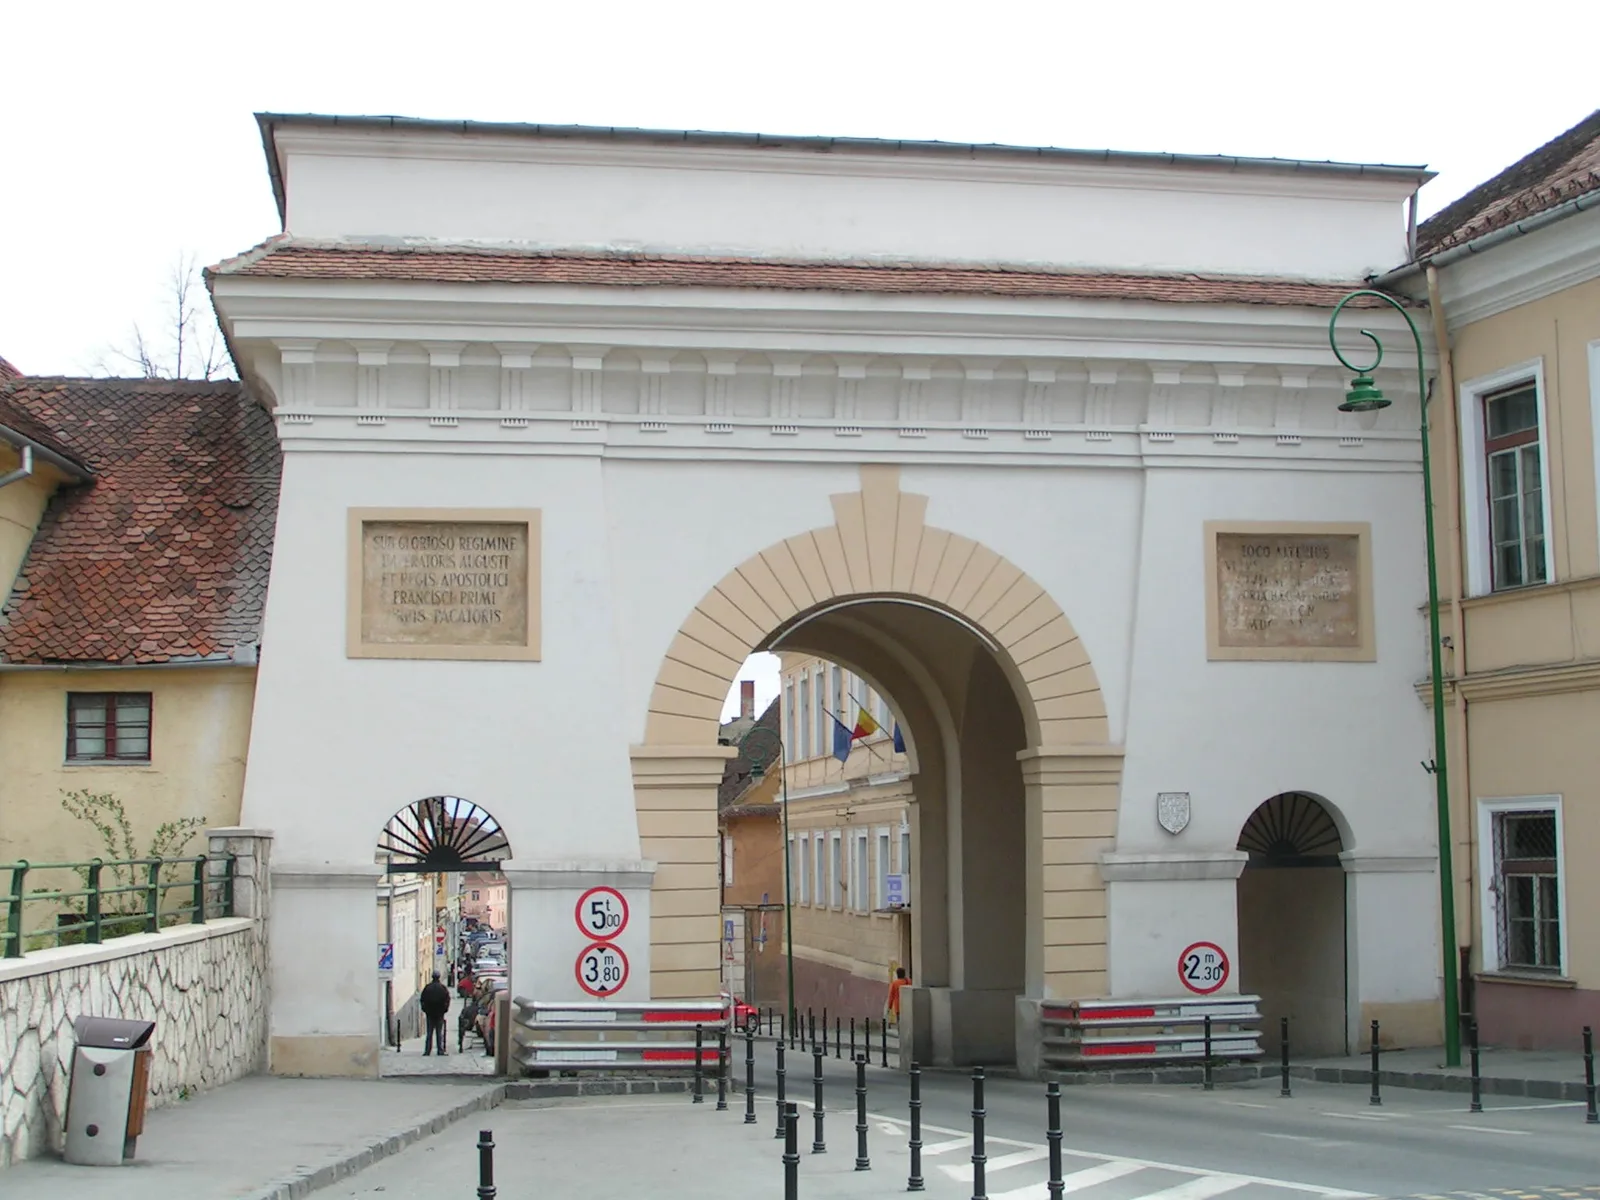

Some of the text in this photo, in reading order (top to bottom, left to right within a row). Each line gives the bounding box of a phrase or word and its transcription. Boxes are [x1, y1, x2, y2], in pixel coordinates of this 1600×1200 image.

[459, 536, 517, 551] REGIMINE
[440, 572, 508, 587] APOSTOLICI
[460, 590, 496, 605] PRIMI
